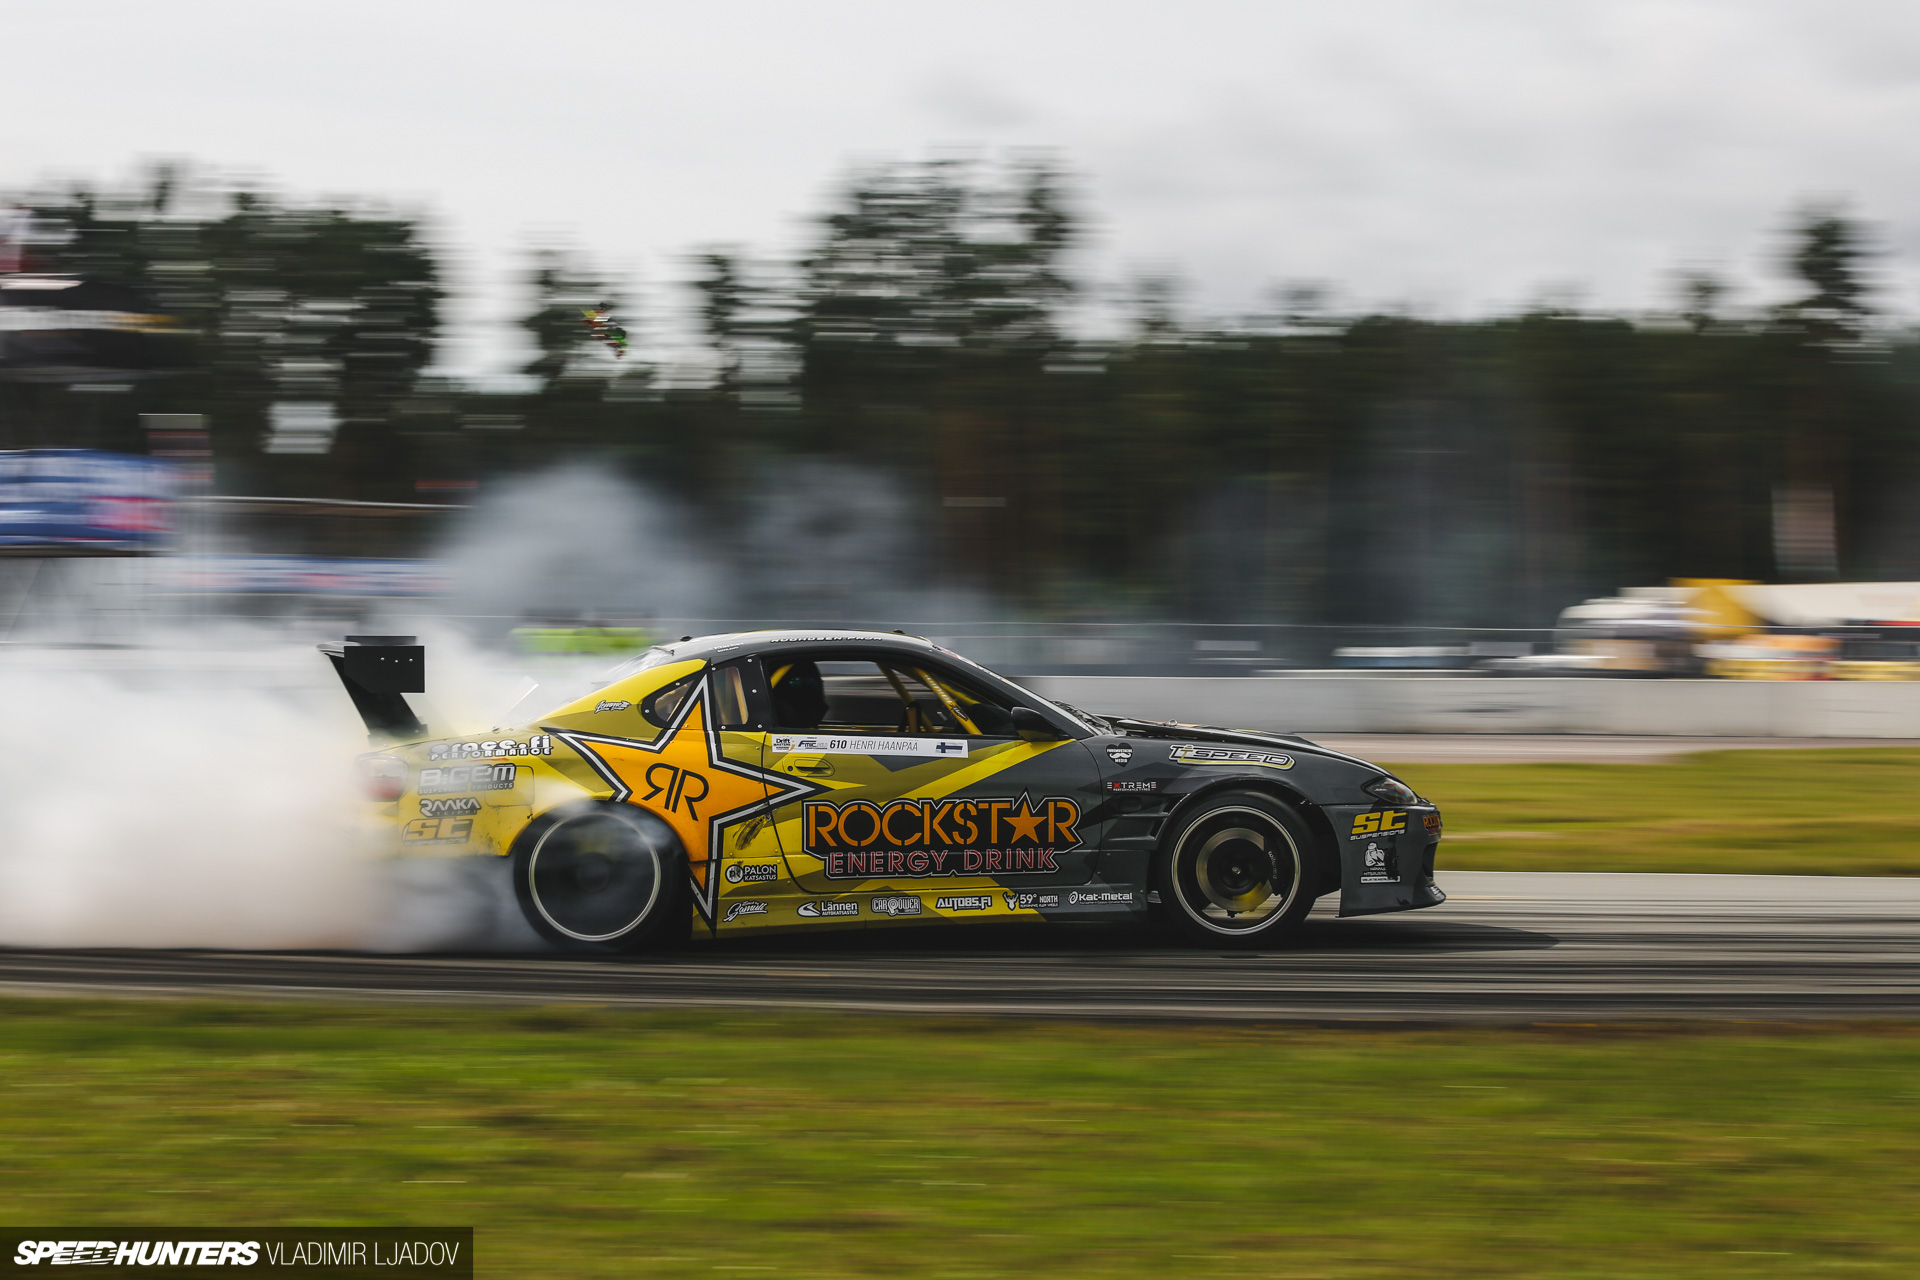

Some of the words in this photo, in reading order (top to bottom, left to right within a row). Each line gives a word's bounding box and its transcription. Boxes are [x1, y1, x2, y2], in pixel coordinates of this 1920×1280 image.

[829, 739, 847, 749] 610
[849, 739, 875, 749] HENRI
[878, 739, 919, 751] HAANPÄÄ
[430, 748, 552, 761] PERFORMANCE
[418, 785, 467, 795] SUSPENSION
[472, 782, 514, 790] PRODUCTS
[1106, 781, 1157, 789] EXTREME
[420, 798, 482, 817] RAAKA
[808, 800, 1077, 847] ROCKSTAR
[1349, 829, 1405, 841] SUSPENSIONS
[829, 850, 948, 873] ENERGY
[963, 848, 1055, 870] DRINK
[744, 866, 777, 875] PALON
[1039, 895, 1059, 903] NORTH
[1079, 893, 1133, 901] Kat-Metal
[821, 901, 858, 911] Lännen
[872, 898, 919, 913] CARPOWER
